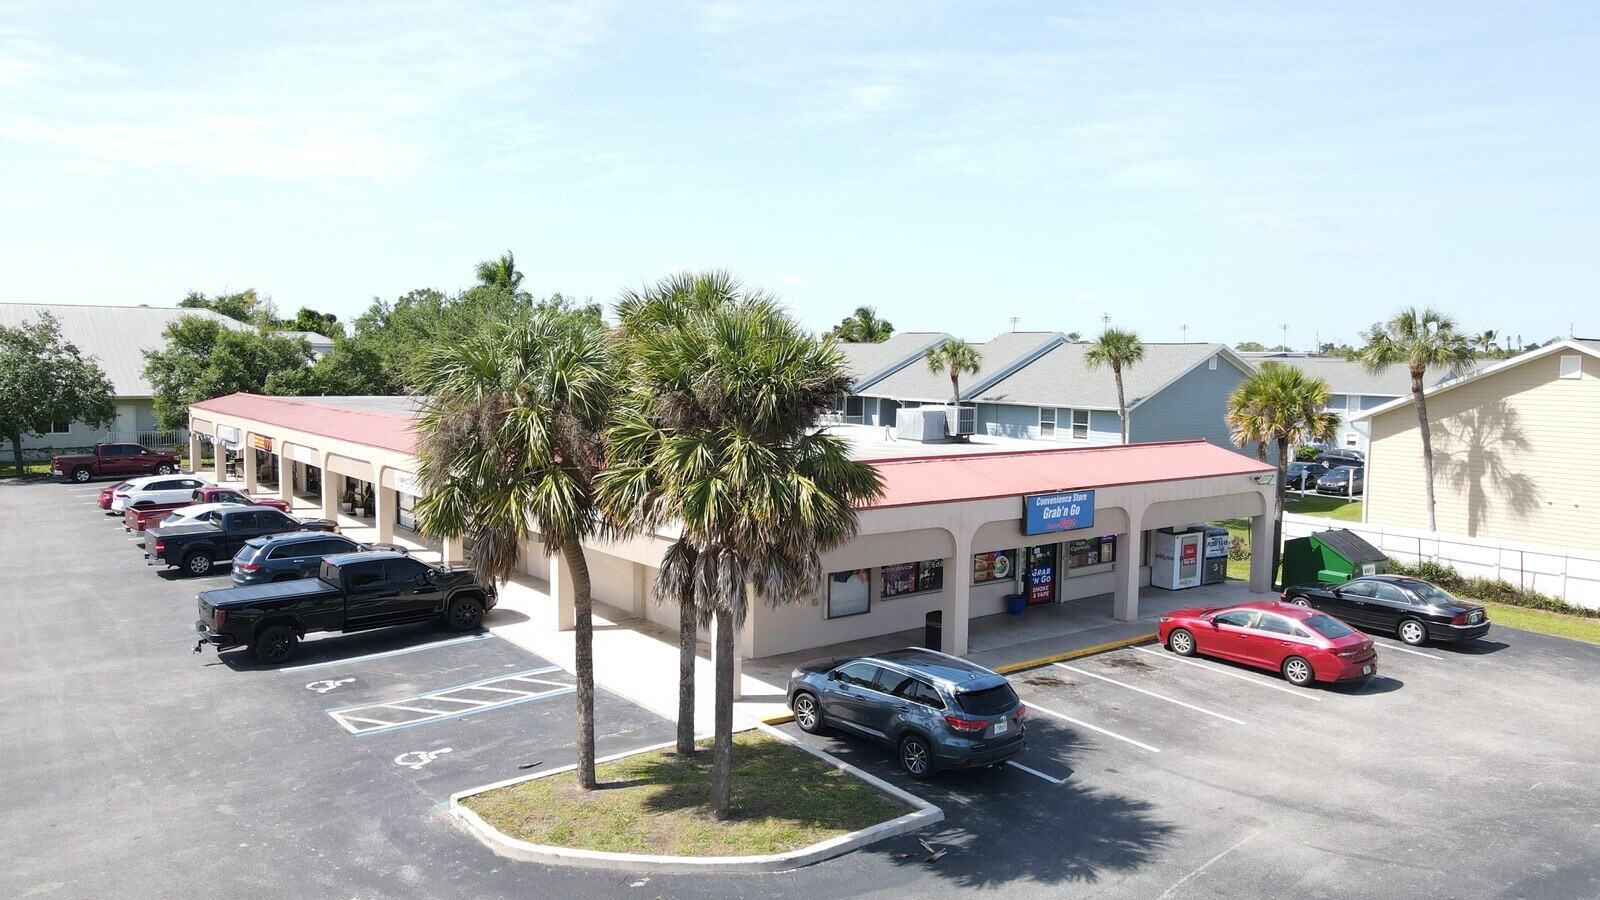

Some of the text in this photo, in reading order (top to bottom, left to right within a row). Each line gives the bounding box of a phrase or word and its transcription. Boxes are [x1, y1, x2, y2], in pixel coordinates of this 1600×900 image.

[1036, 493, 1087, 506] Convenience Store
[1043, 504, 1080, 519] Grab'n Go
[1032, 568, 1051, 577] GRAB
[1040, 575, 1051, 584] GO
[1032, 585, 1050, 593] SMOKE
[1037, 590, 1050, 599] VAPE
